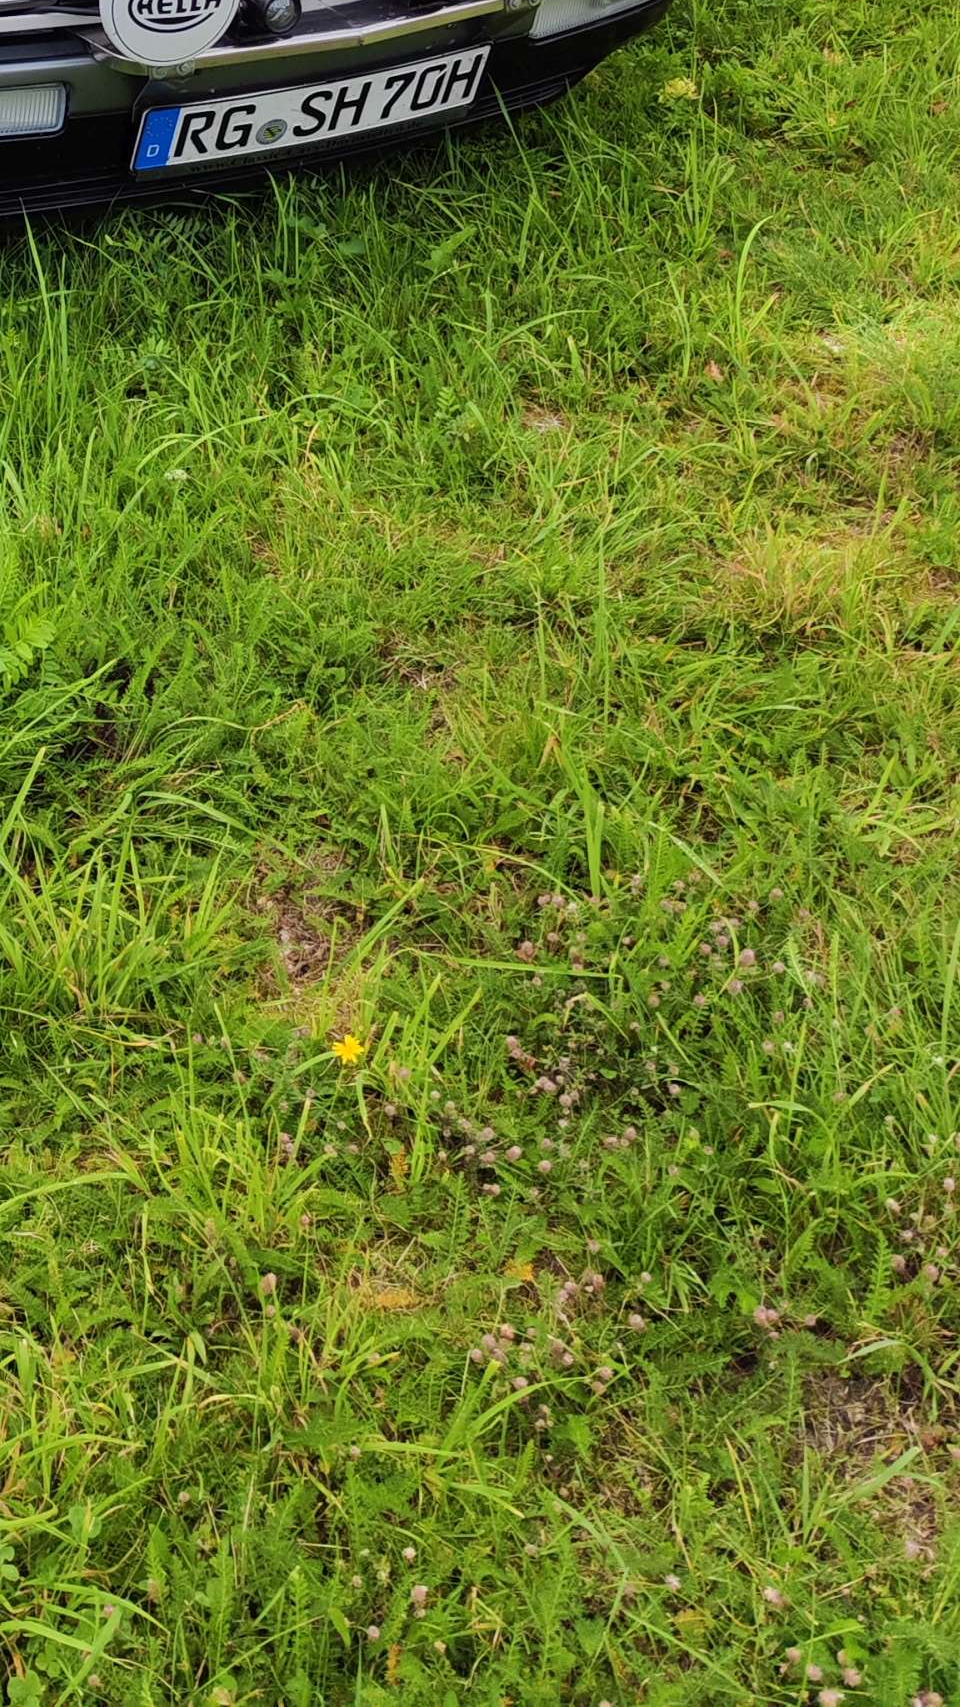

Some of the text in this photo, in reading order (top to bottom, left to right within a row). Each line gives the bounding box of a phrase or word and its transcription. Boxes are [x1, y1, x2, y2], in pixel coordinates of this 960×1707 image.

[173, 104, 257, 157] RG
[292, 81, 373, 137] SH
[380, 54, 483, 119] 70H
[146, 144, 160, 158] D
